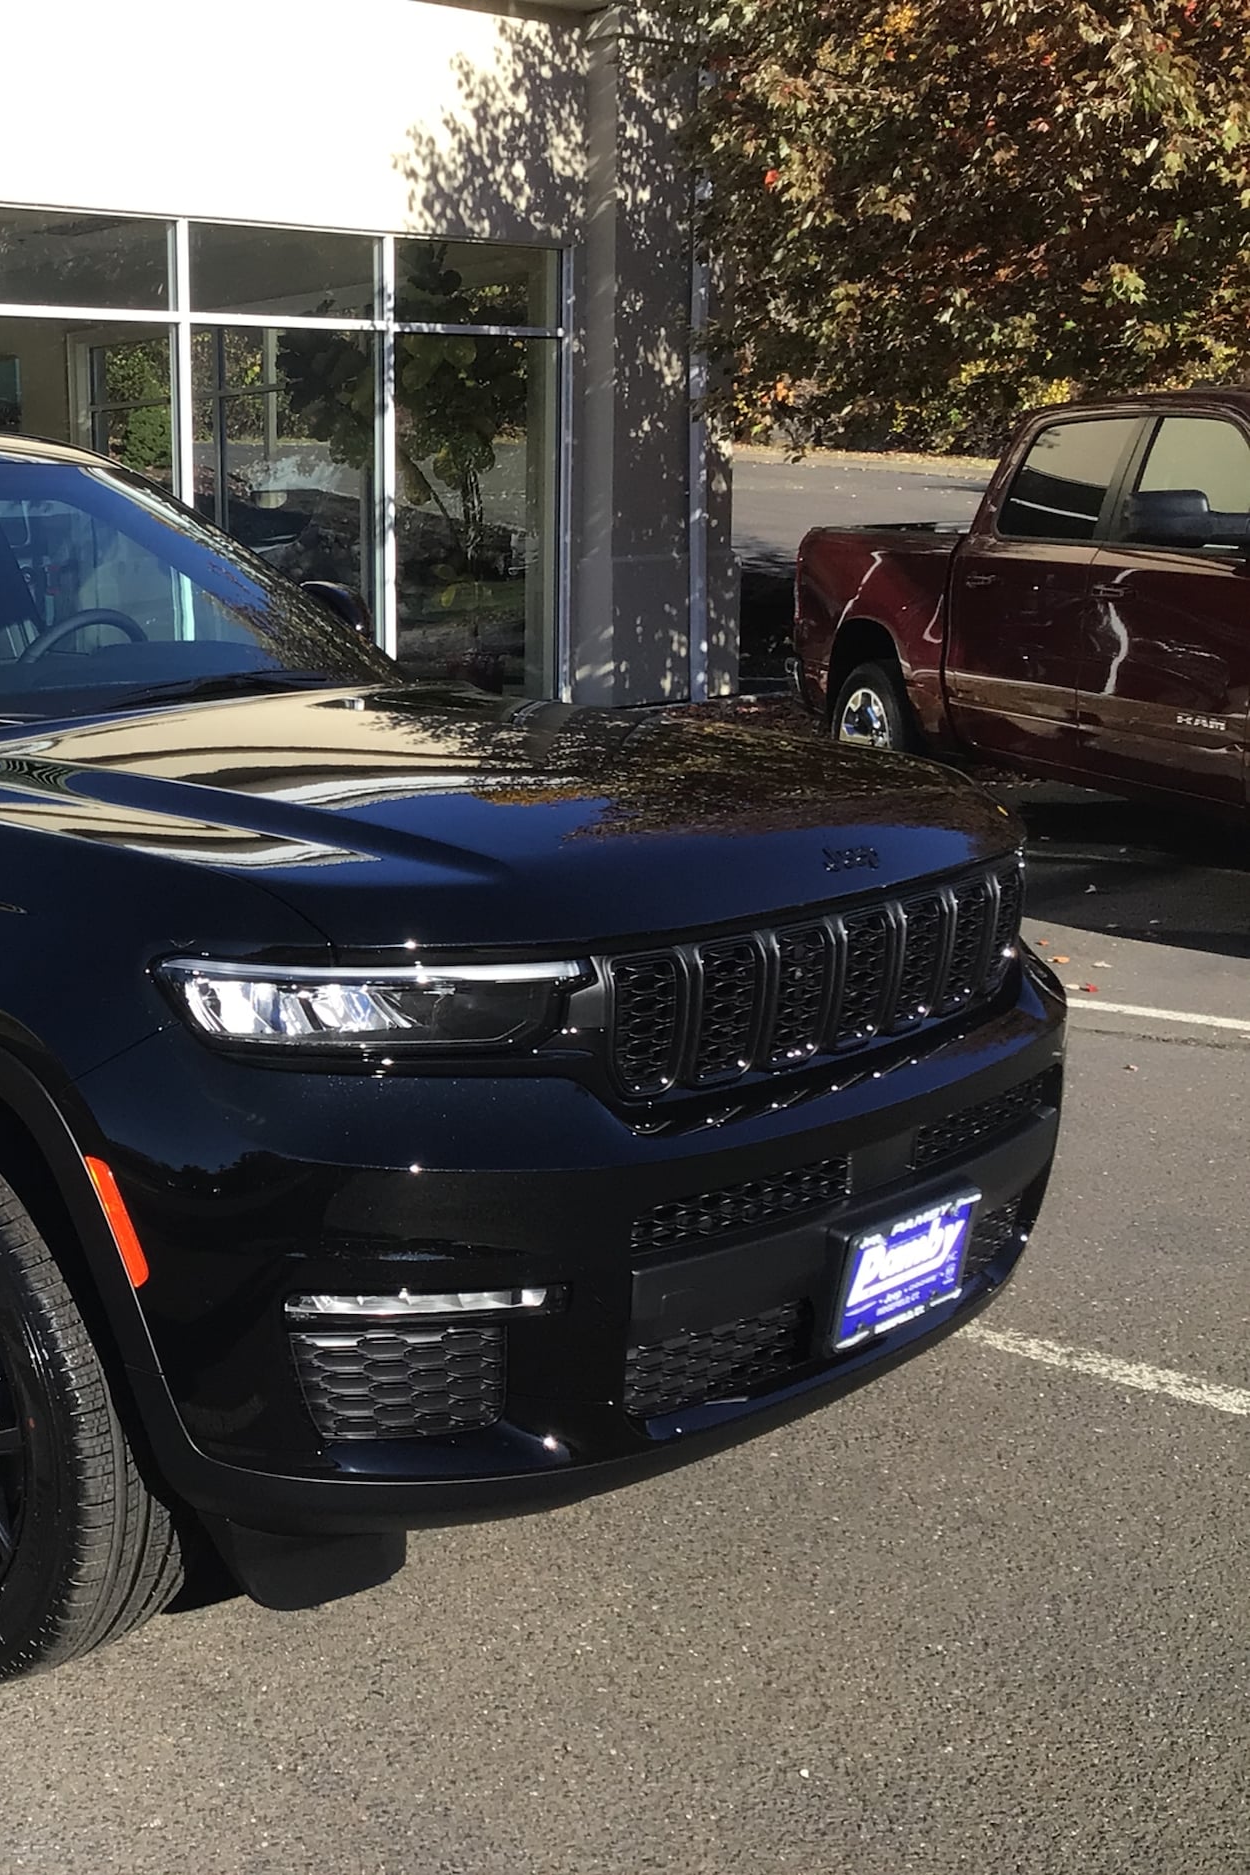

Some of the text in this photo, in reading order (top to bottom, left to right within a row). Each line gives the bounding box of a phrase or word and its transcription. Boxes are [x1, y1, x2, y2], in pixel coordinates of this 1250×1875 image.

[1176, 711, 1227, 731] RAM
[822, 846, 879, 872] Jeep
[891, 1203, 953, 1236] PAMBY
[846, 1217, 966, 1308] Pamby
